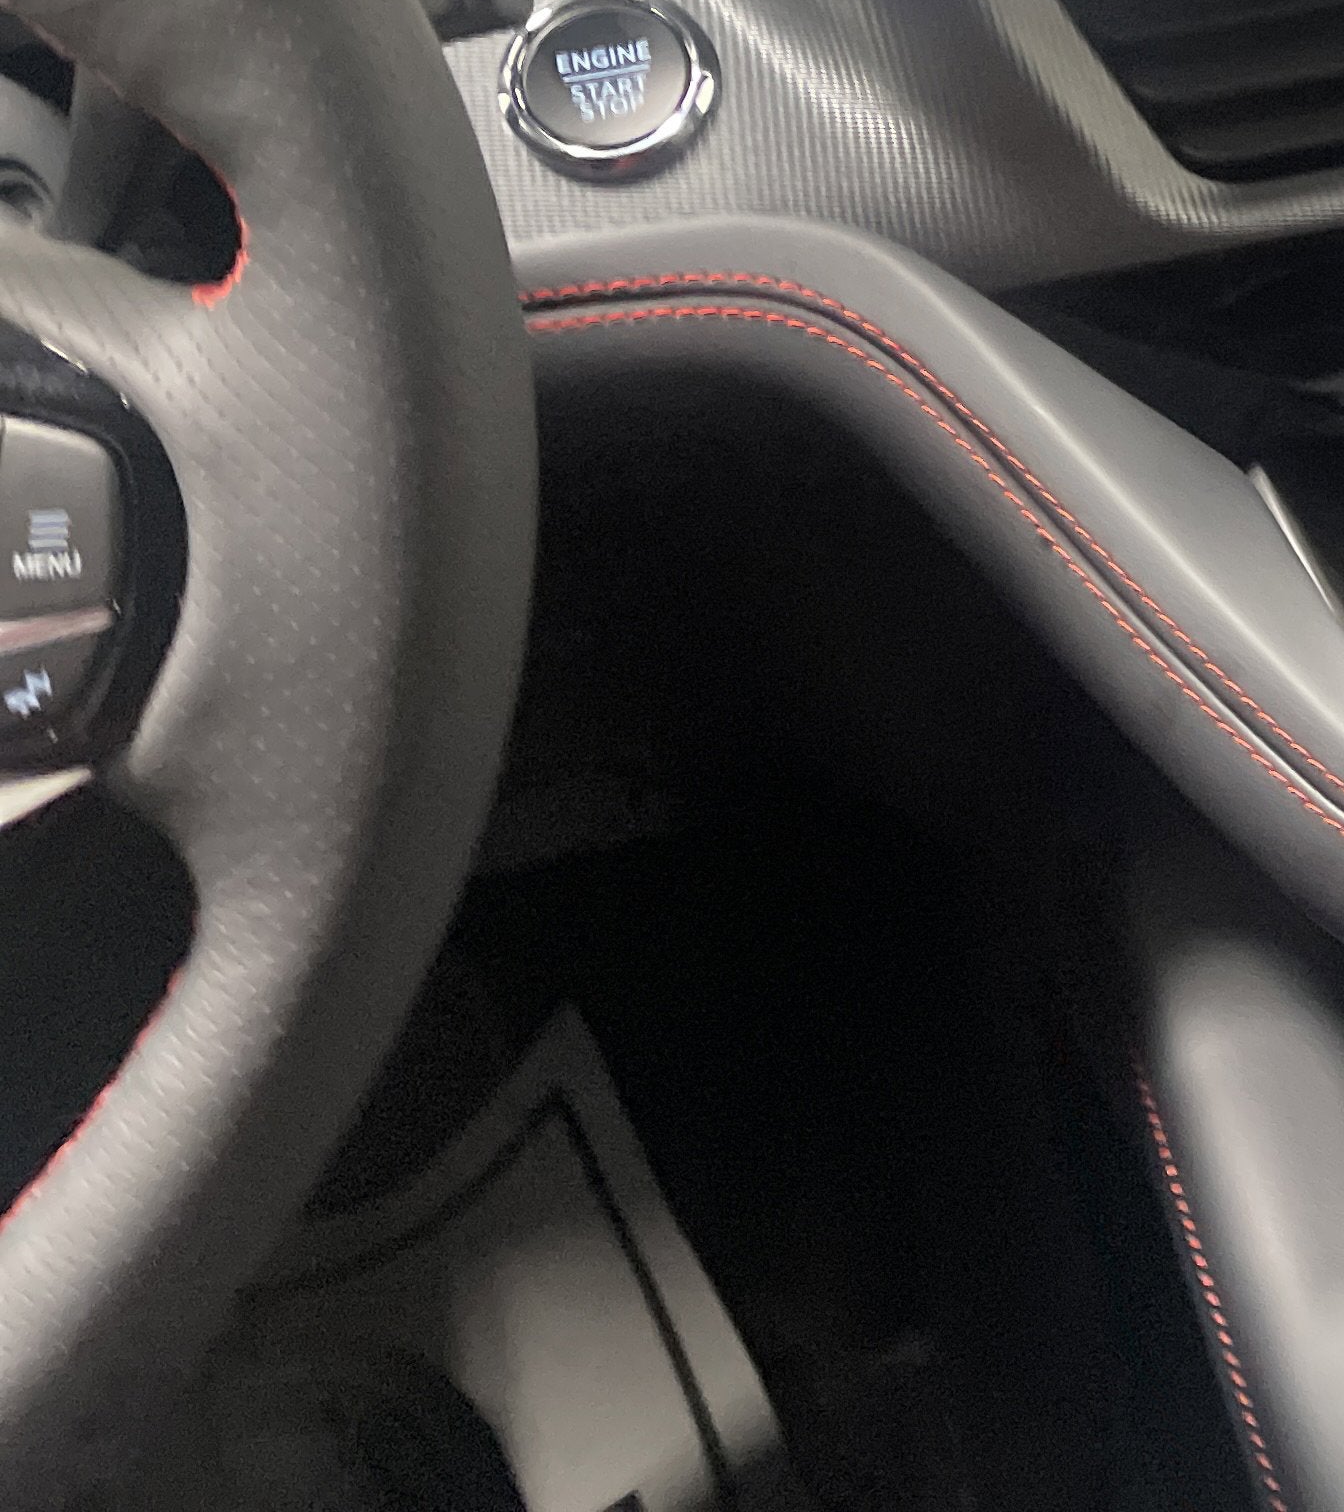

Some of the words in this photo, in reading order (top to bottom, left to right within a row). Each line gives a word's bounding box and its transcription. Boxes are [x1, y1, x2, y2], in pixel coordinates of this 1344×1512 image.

[555, 38, 652, 75] ENGINE
[570, 74, 645, 101] START
[579, 94, 645, 122] STOP
[12, 548, 83, 582] MENU
